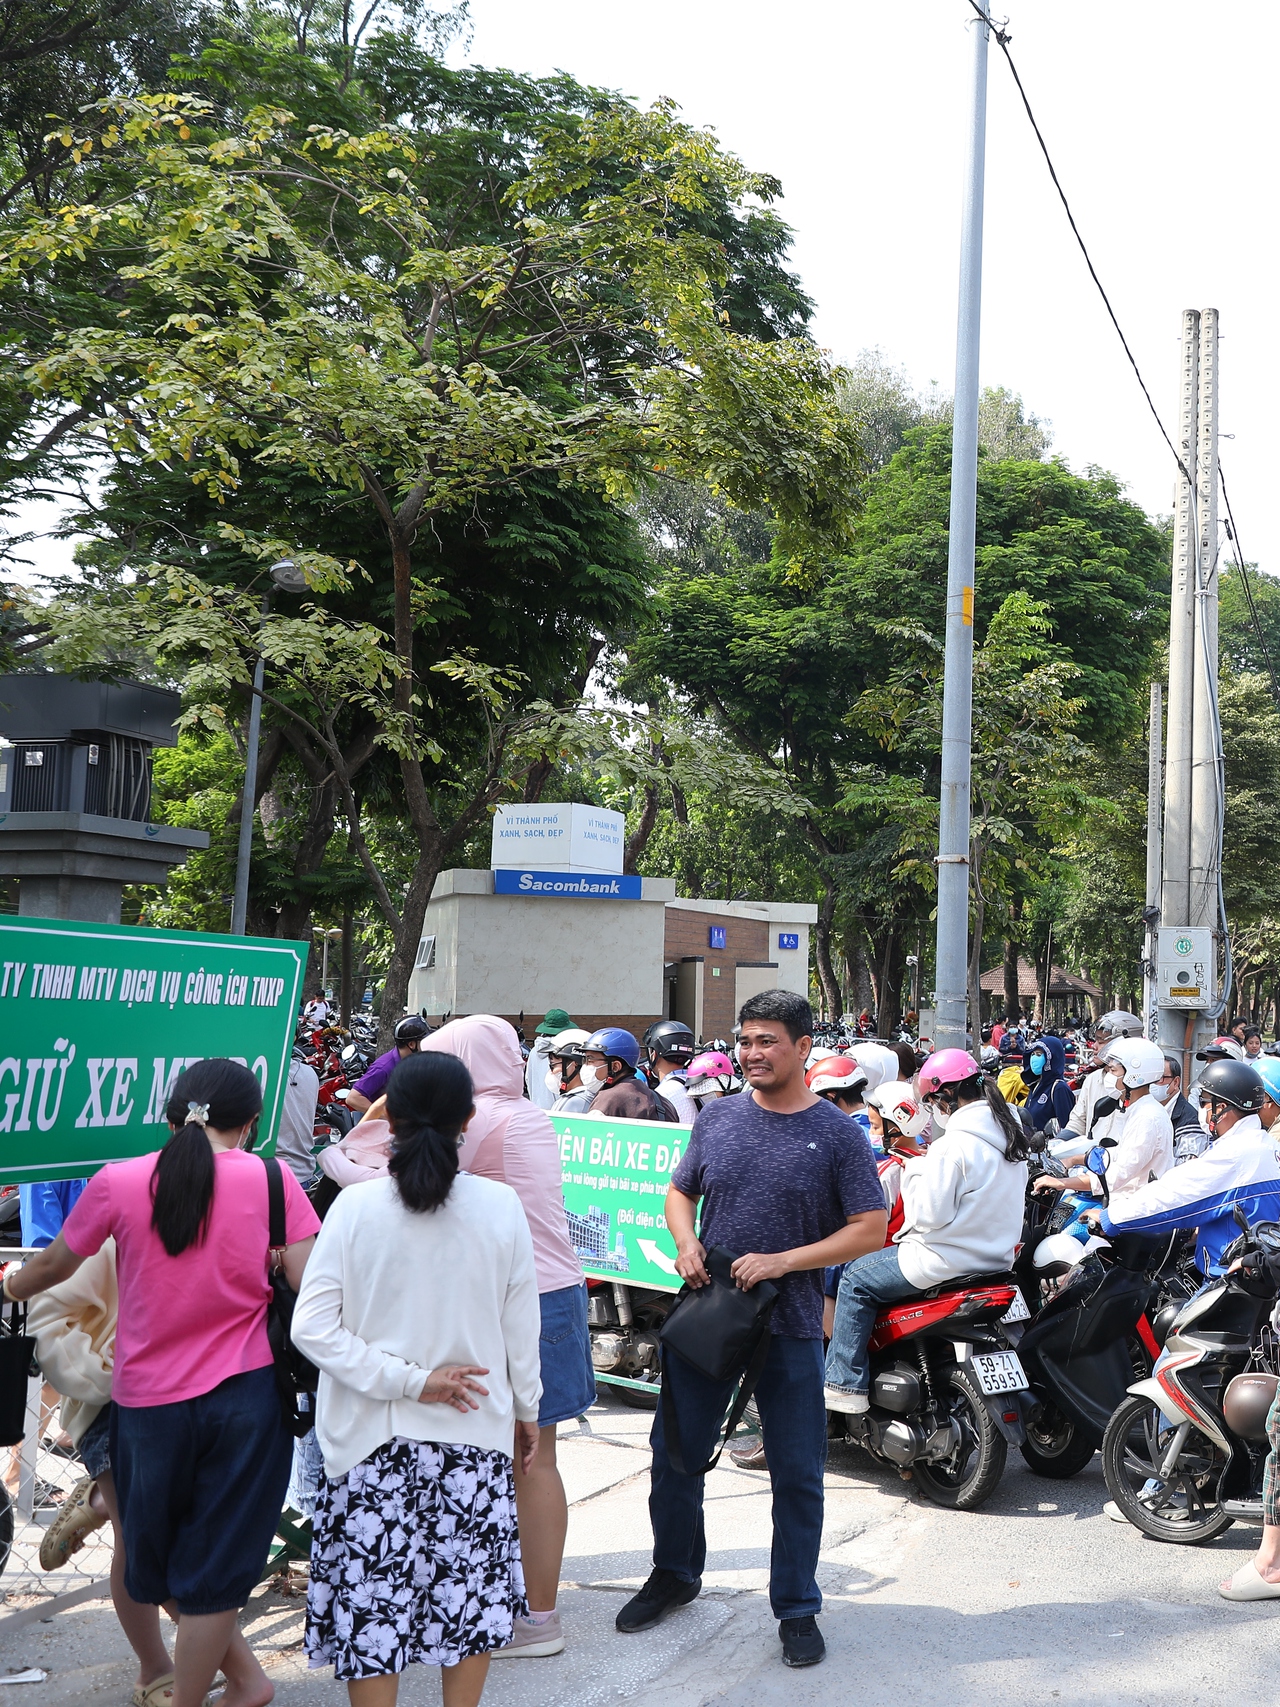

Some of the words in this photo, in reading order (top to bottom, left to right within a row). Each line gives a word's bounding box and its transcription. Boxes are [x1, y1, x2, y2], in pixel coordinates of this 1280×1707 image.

[506, 816, 514, 825] VÌ
[515, 815, 540, 825] THÀNH
[543, 813, 559, 824] PHỐ
[548, 829, 564, 840] ĐẸP
[518, 873, 620, 894] Sacombank
[1, 961, 27, 998] TY
[30, 963, 76, 1000] TNHH
[77, 966, 118, 1001] MTV
[119, 968, 157, 1008] DỊCH
[160, 970, 182, 1010] VỤ
[184, 966, 223, 1006] CÔNG
[224, 968, 249, 1006] ÍCH
[250, 976, 285, 1007] TNXP
[0, 1037, 76, 1133] GIỮ
[74, 1057, 138, 1129] XE
[589, 1132, 622, 1168] BÃI
[624, 1141, 651, 1171] XE
[655, 1139, 682, 1174] ĐÃ
[573, 1172, 583, 1185] vui
[584, 1172, 597, 1190] lòng
[610, 1176, 619, 1192] tại
[619, 1177, 630, 1191] bãi
[630, 1183, 639, 1192] xe
[639, 1180, 654, 1196] phía
[635, 1211, 654, 1229] diện
[979, 1354, 1014, 1373] 59-Z1
[982, 1370, 1025, 1392] 559.51
